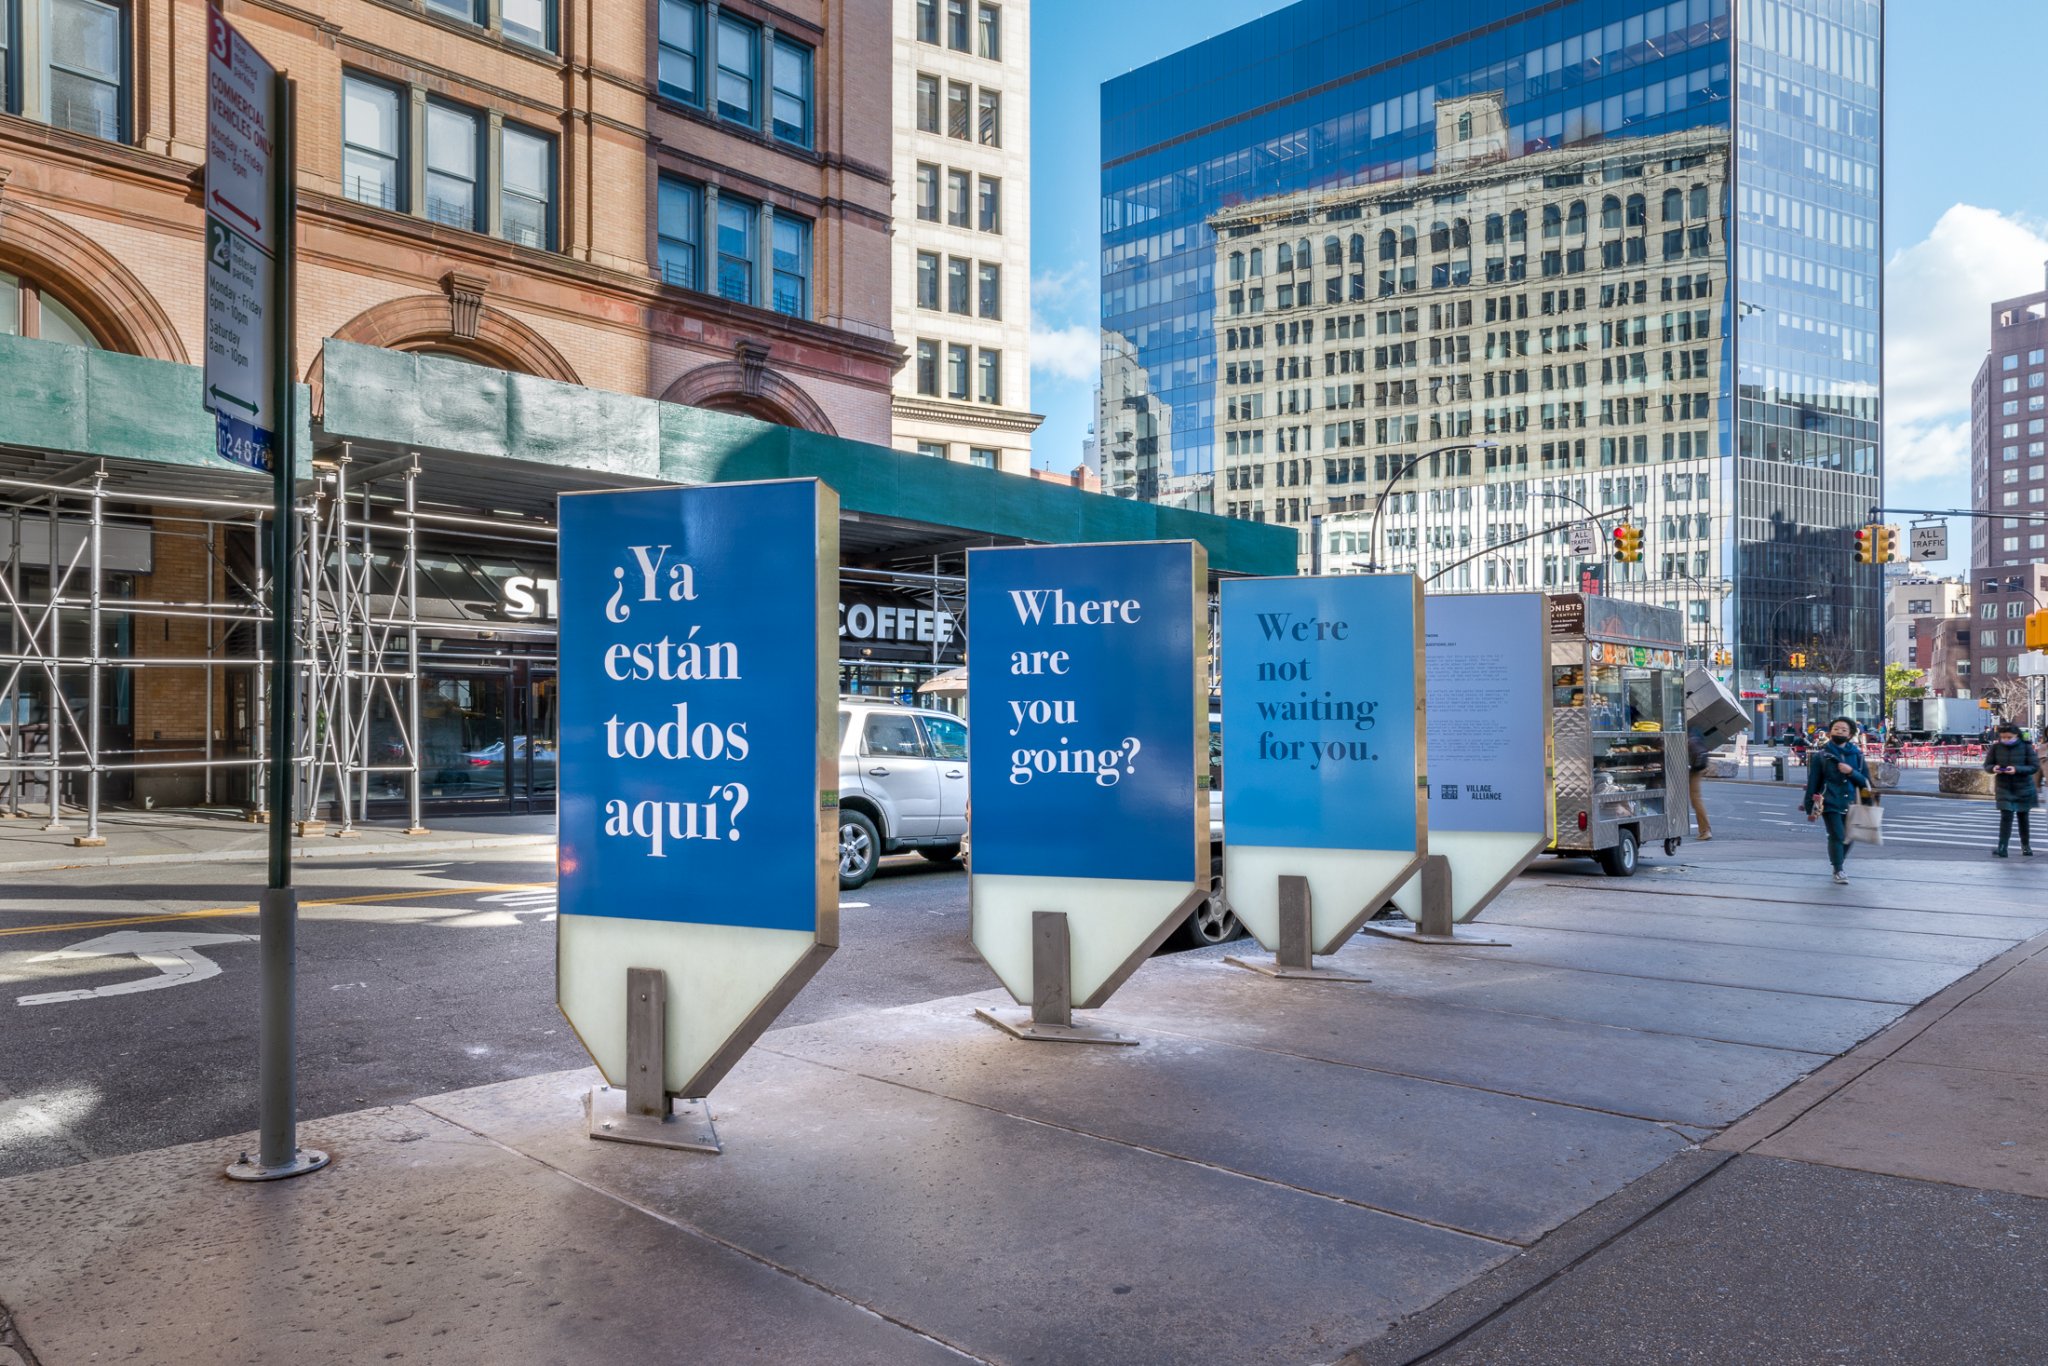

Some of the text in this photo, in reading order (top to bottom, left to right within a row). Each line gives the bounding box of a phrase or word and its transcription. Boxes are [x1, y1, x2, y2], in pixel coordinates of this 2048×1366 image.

[213, 18, 227, 60] 3
[233, 67, 256, 94] parking
[234, 53, 258, 80] metered
[211, 71, 266, 131] COMMERCIAL
[211, 93, 274, 159] VEHICLES ONLY
[211, 121, 238, 157] Monday
[243, 148, 265, 177] Friday
[211, 140, 227, 163] 8am
[232, 158, 247, 179] 6pm
[213, 226, 225, 266] 2
[233, 236, 246, 254] hour
[232, 253, 257, 276] metered
[232, 268, 254, 290] parking
[209, 275, 237, 305] Monday
[242, 294, 263, 319] Friday
[209, 293, 225, 313] 6pm
[231, 305, 249, 326] 10pm
[209, 318, 241, 349] Saturday
[209, 336, 225, 356] 8am
[230, 347, 249, 367] 10pm
[1571, 538, 1592, 546] TRAFFIC
[1574, 531, 1588, 539] ALL
[1912, 539, 1945, 548] TRAFFIC
[1919, 530, 1939, 539] ALL
[604, 545, 698, 623] ¿Ya
[1007, 588, 1141, 626] Where
[1256, 612, 1350, 642] We're
[604, 625, 742, 681] están
[1010, 647, 1070, 675] are
[1256, 657, 1312, 682] not
[1008, 695, 1079, 735] you
[1256, 690, 1380, 731] waiting
[604, 701, 749, 761] todos
[1009, 736, 1142, 787] going?
[1258, 730, 1380, 771] for you.
[1466, 784, 1492, 792] VILLAGE
[1471, 792, 1502, 800] ALLIANCE
[604, 781, 749, 858] aquí?
